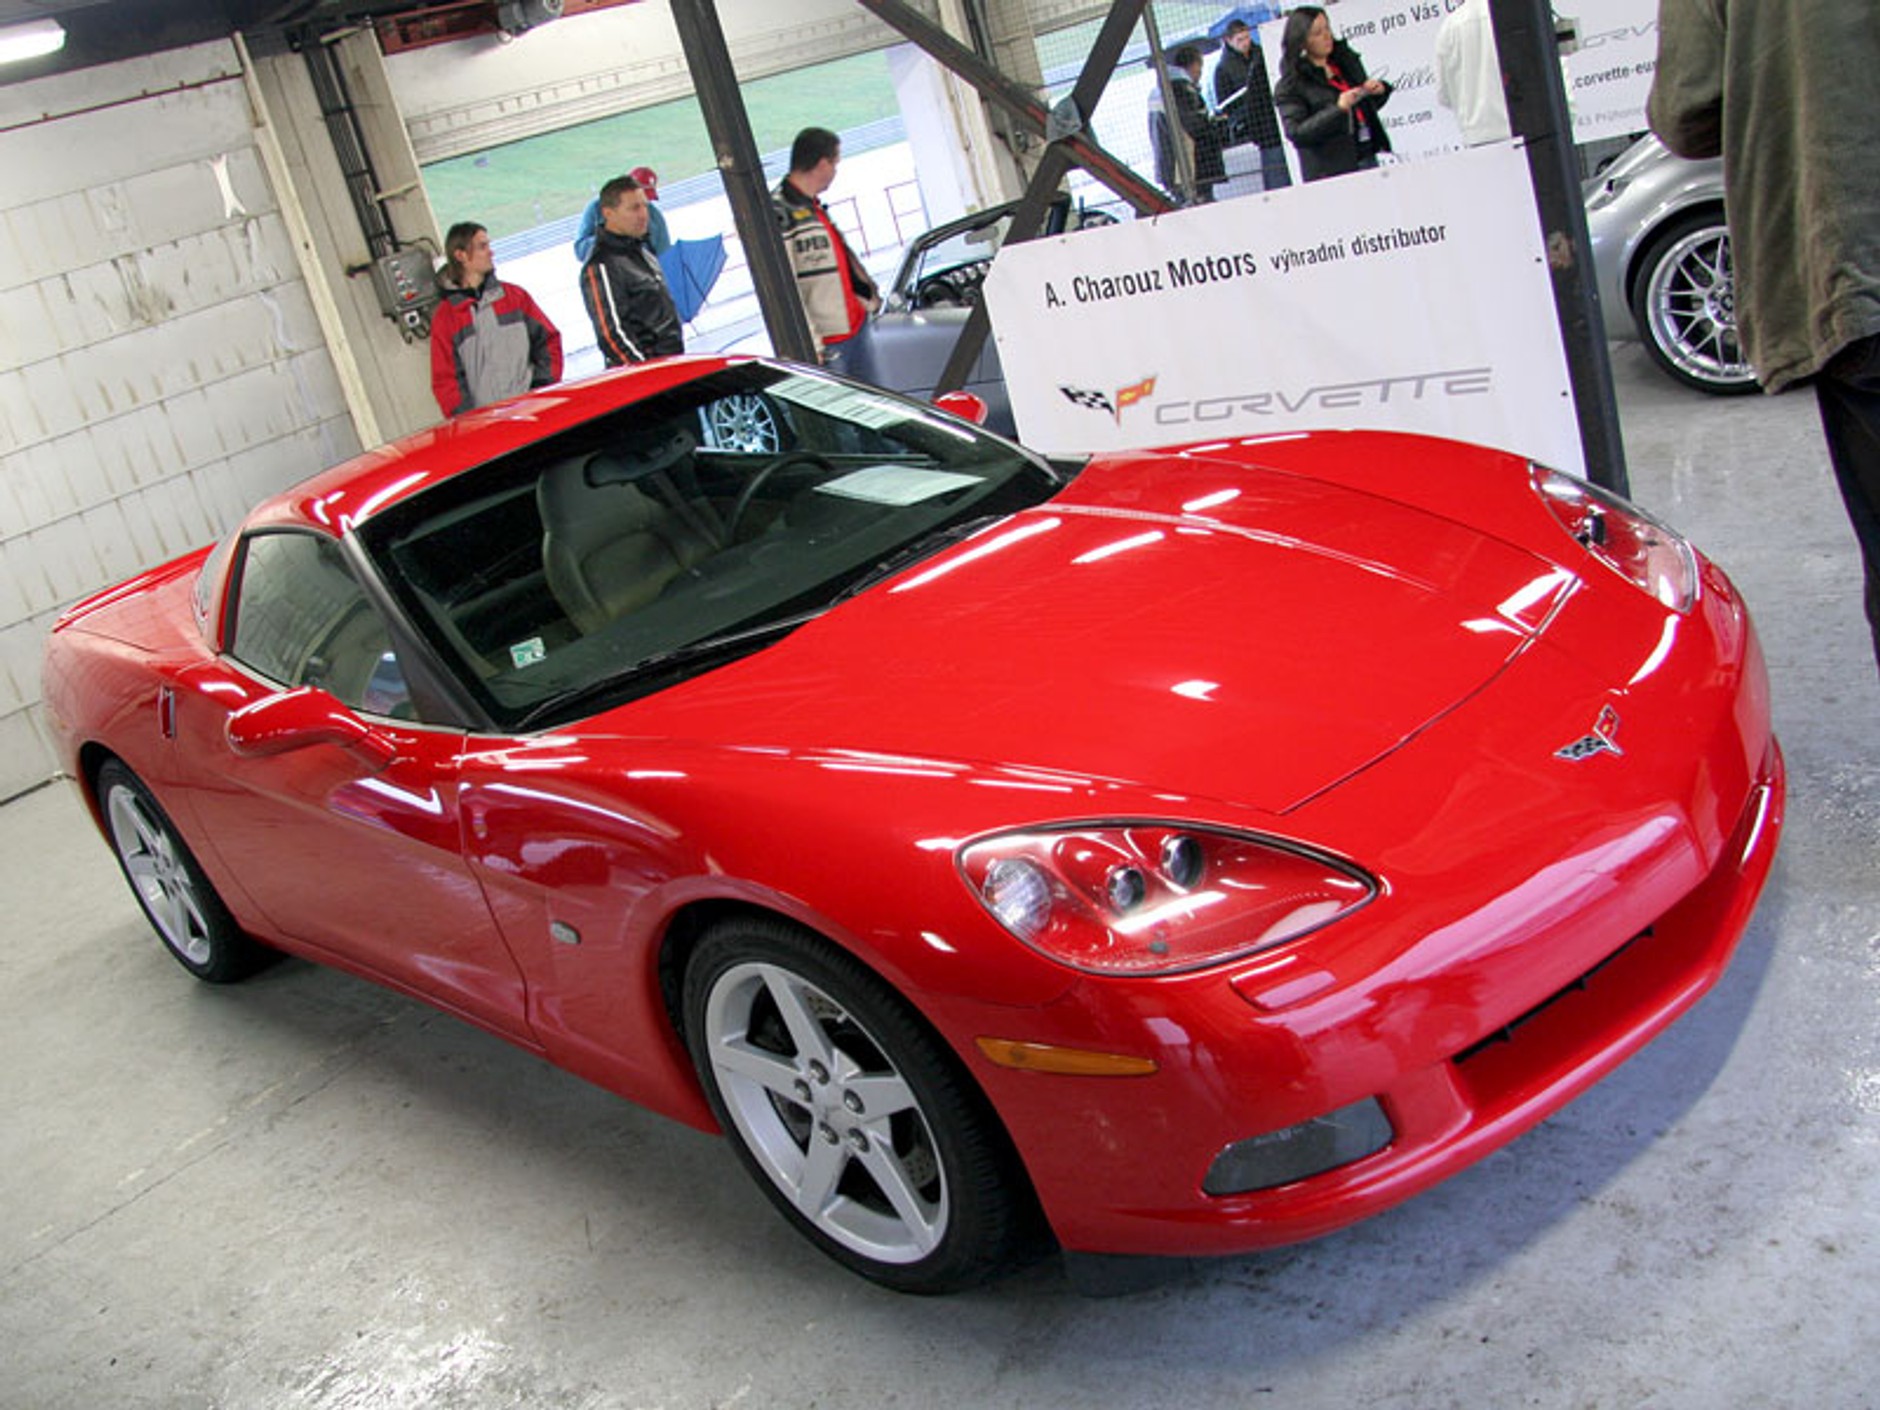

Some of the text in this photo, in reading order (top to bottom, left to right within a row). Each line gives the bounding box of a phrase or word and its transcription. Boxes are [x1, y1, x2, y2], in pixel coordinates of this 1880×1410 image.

[1381, 13, 1407, 35] pro
[1045, 224, 1447, 309] A. Charouz Motors výhradní distributor
[1154, 366, 1493, 426] CORVETTE
